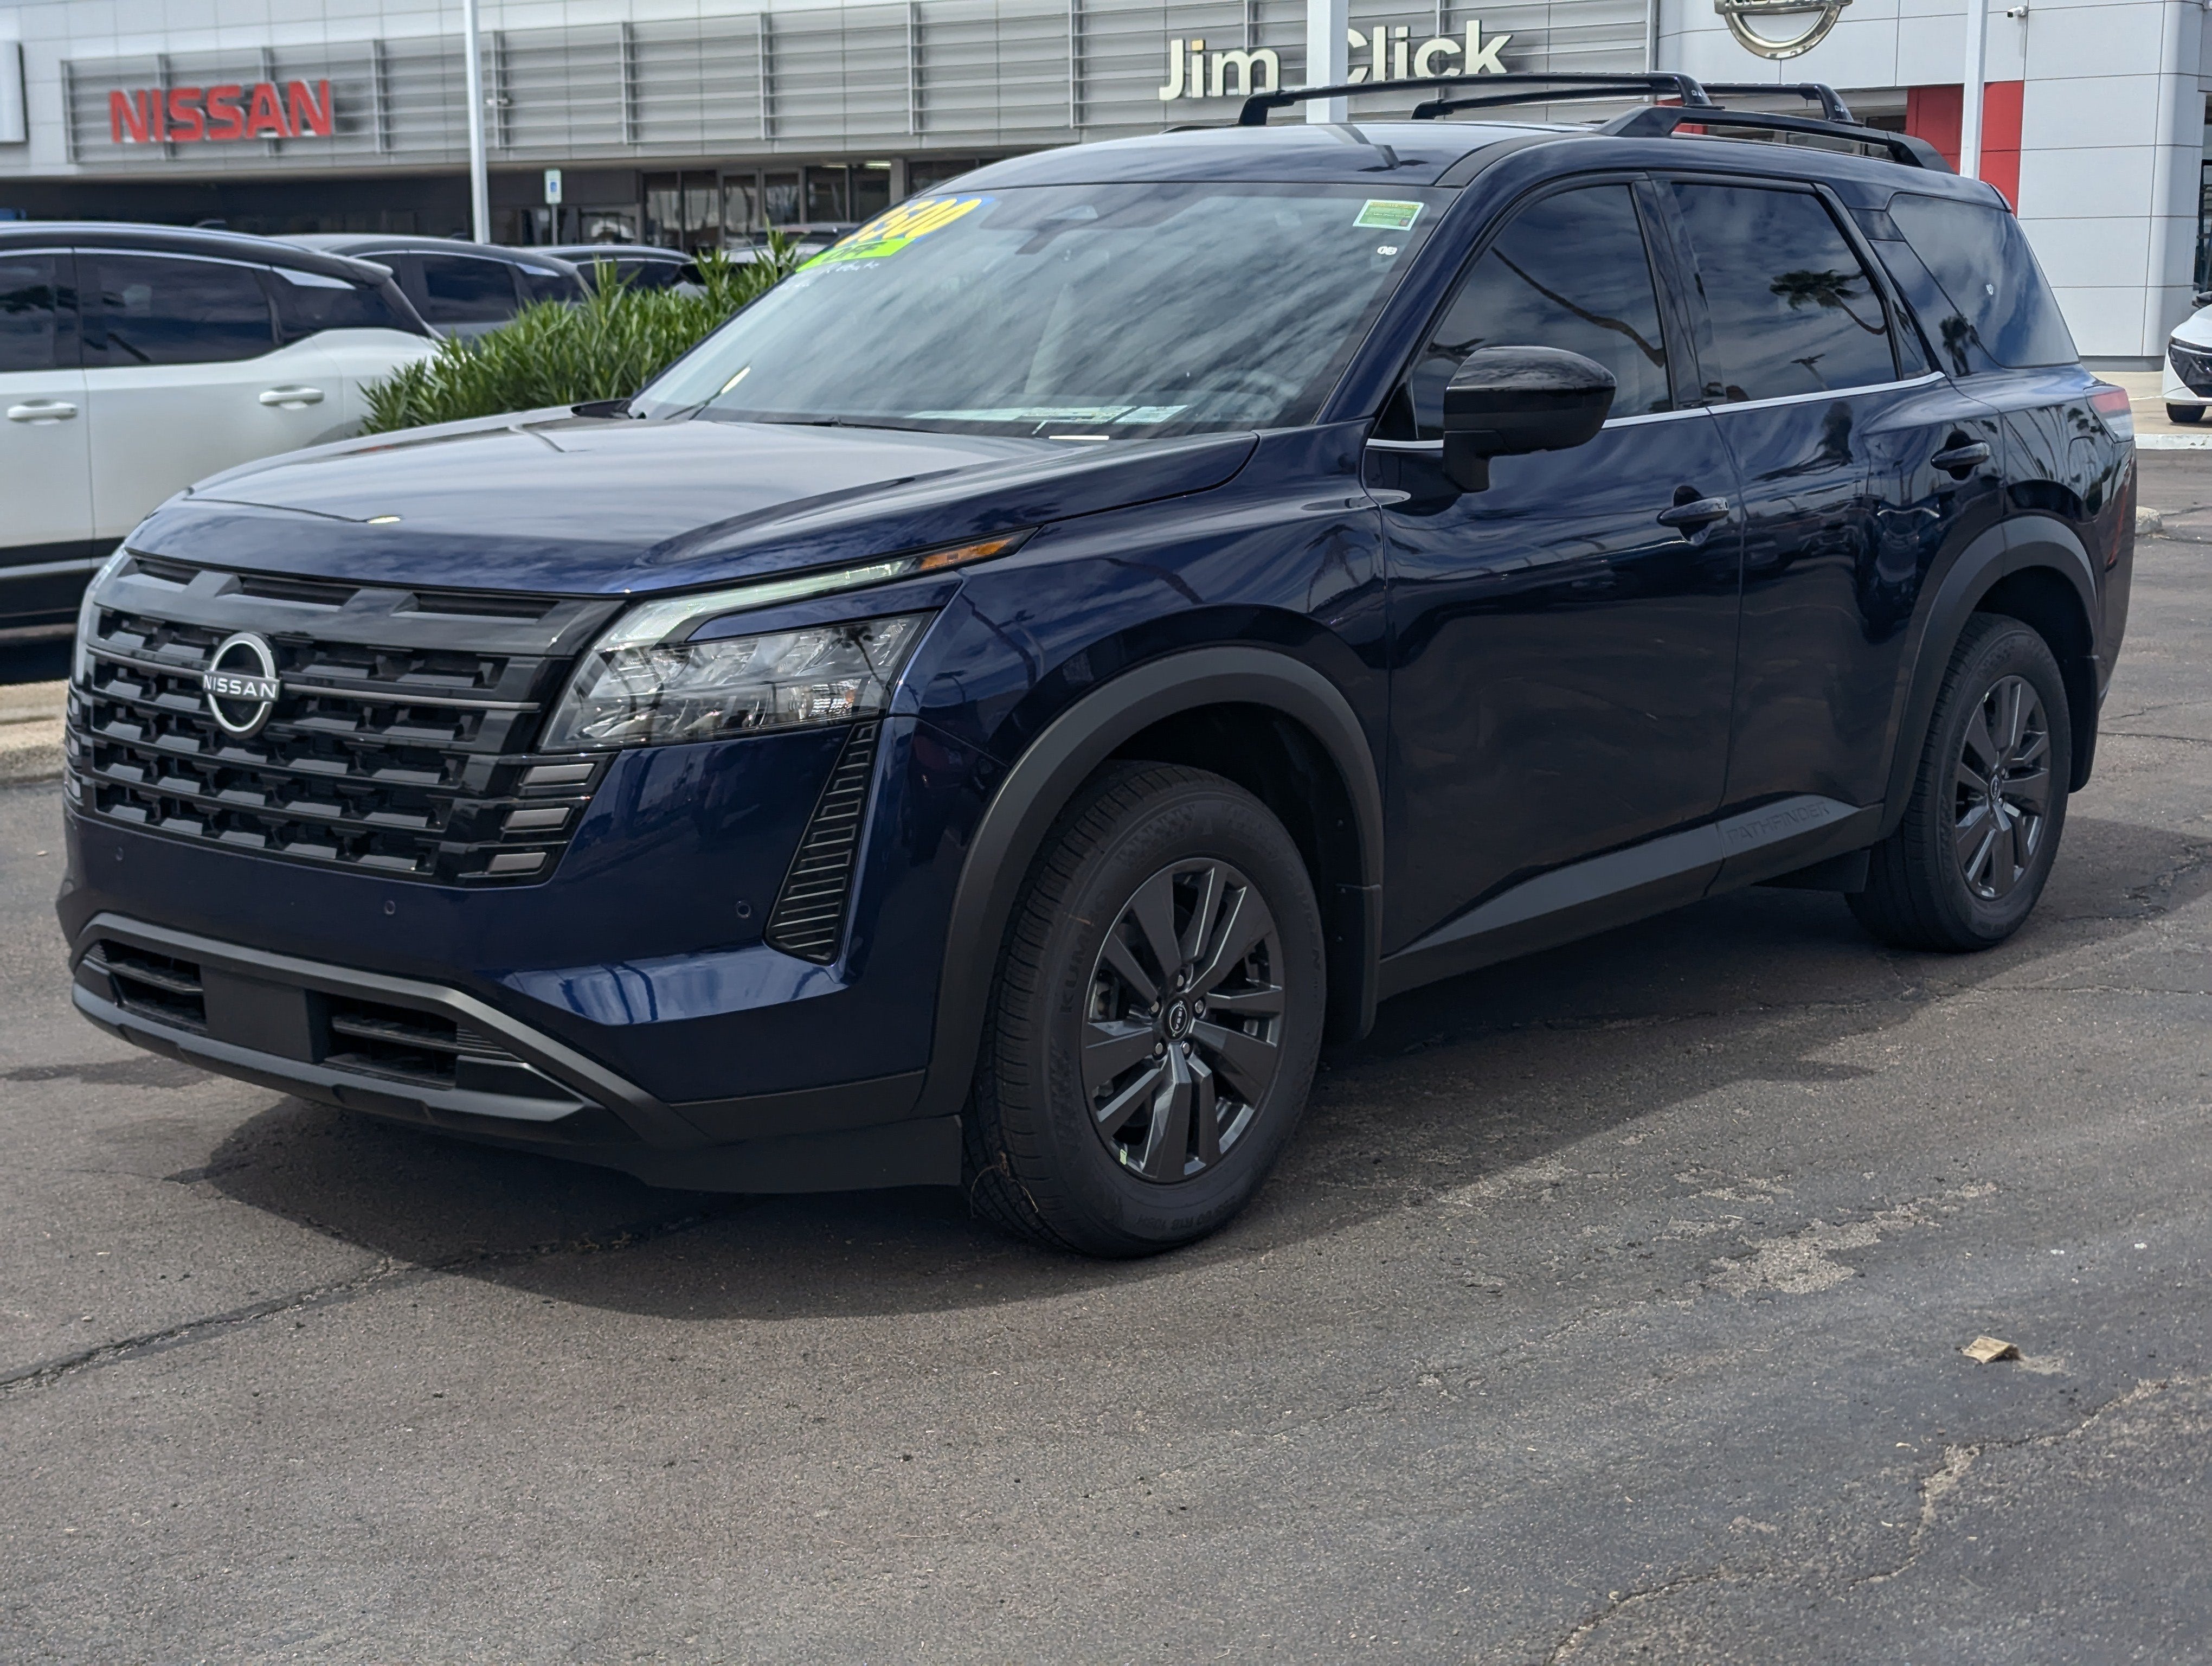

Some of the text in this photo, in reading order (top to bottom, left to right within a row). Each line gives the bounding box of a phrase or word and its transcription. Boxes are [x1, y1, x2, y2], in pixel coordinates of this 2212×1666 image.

[1159, 39, 1279, 100] Jim
[110, 79, 332, 143] NISSAN
[203, 674, 276, 698] NISSAN
[1726, 802, 1830, 843] PATHFINDER
